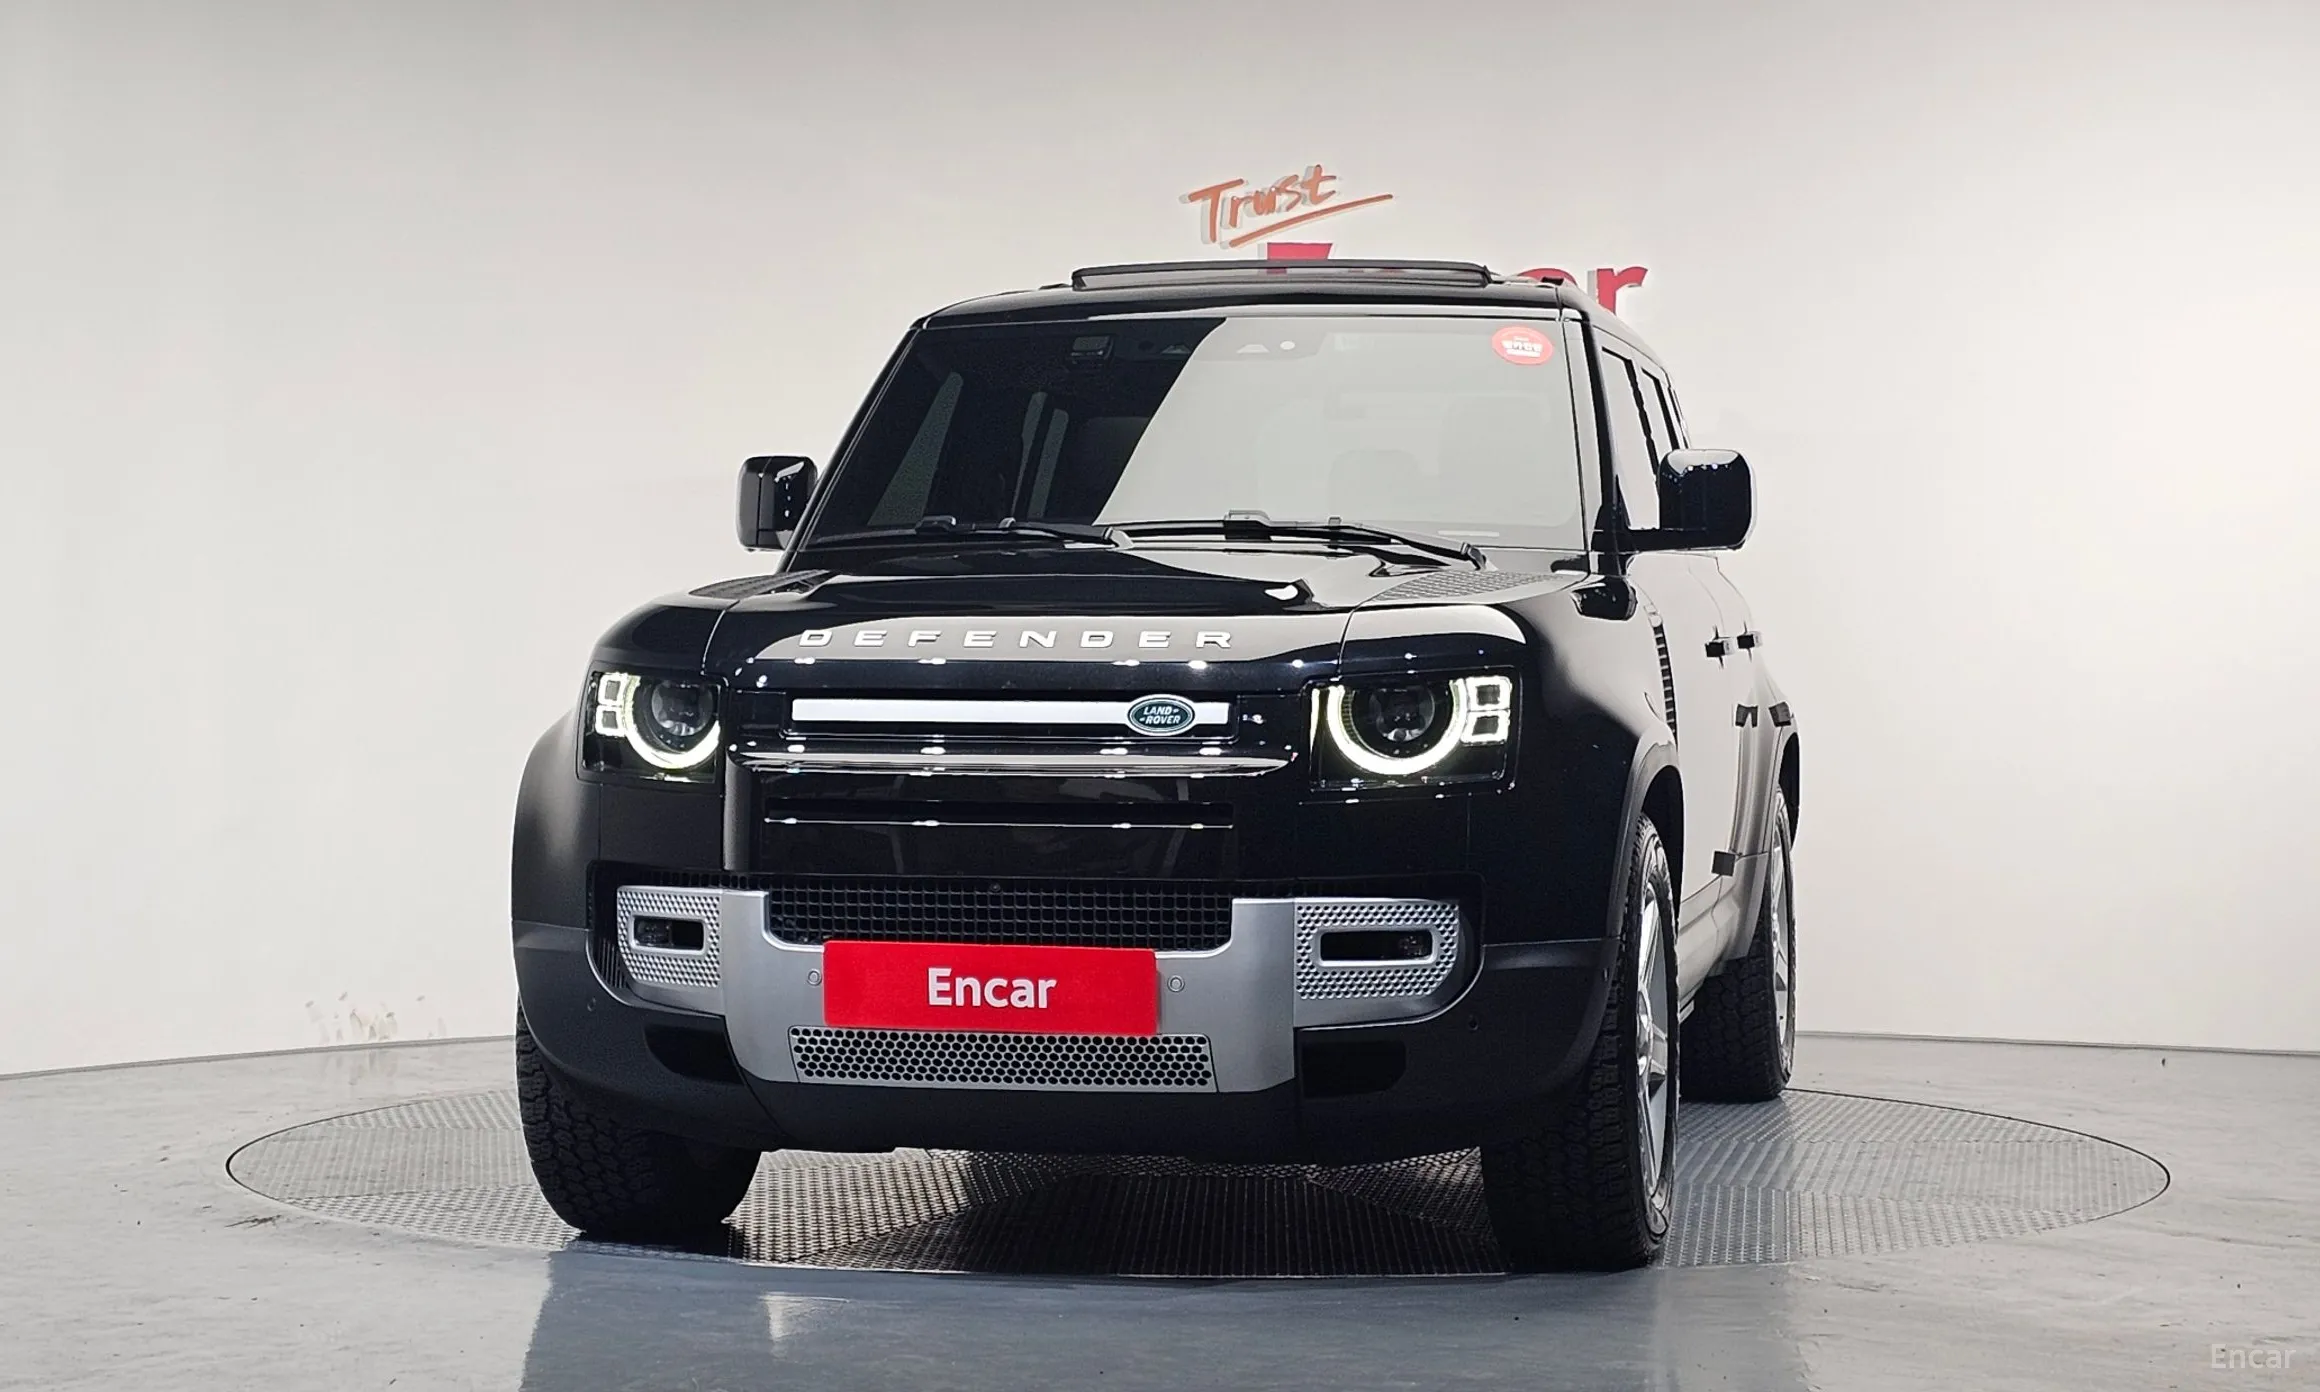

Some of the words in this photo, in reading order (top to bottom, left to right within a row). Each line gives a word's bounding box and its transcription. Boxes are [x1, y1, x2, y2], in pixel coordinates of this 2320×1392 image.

[1186, 164, 1338, 244] Trust
[798, 629, 1234, 649] DEFENDER
[1143, 705, 1173, 716] LAND
[1145, 715, 1181, 725] ROVER
[926, 966, 1057, 1009] Encar
